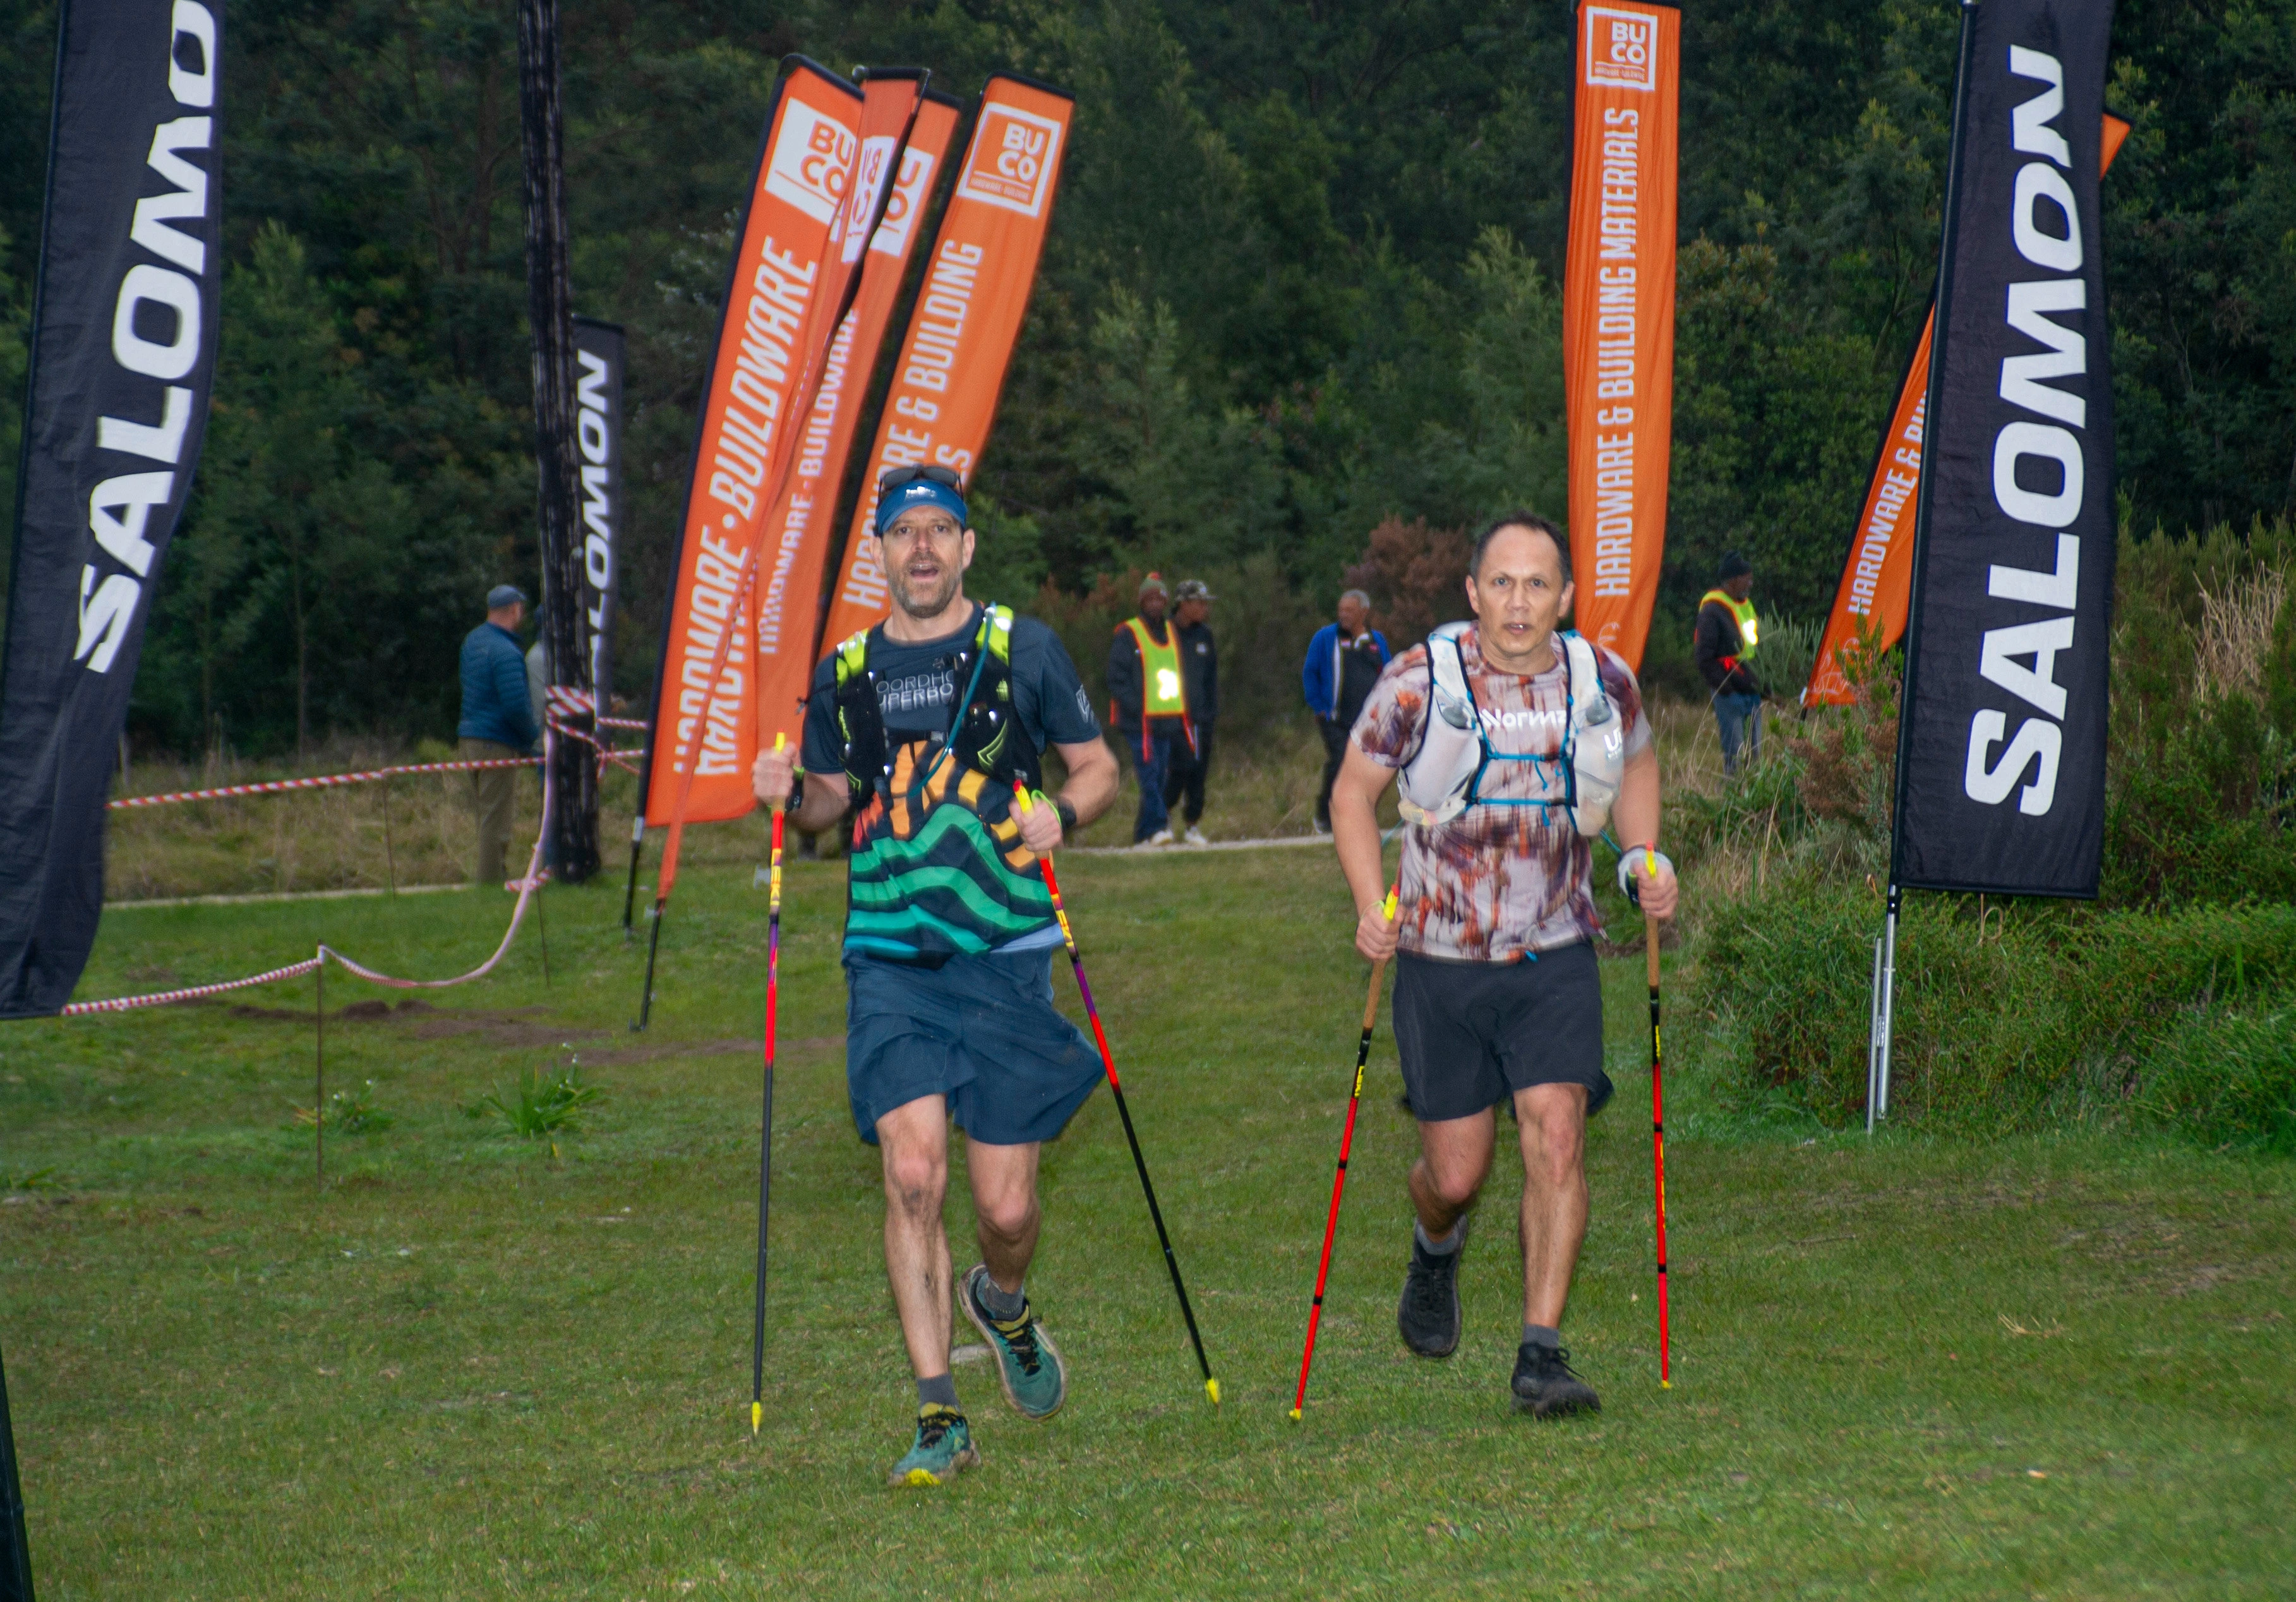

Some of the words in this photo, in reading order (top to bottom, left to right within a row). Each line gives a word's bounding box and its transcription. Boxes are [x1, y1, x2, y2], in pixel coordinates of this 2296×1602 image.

[1600, 107, 1640, 260] MATERIALS
[709, 235, 817, 521] BUILDWARE
[903, 238, 983, 393] BUILDING
[1597, 266, 1637, 399] BUILDING
[1597, 405, 1635, 425] &
[1965, 44, 2087, 816] SALOMON
[1595, 432, 1634, 597] HARDWARE
[1848, 467, 1917, 616] HARDWARE
